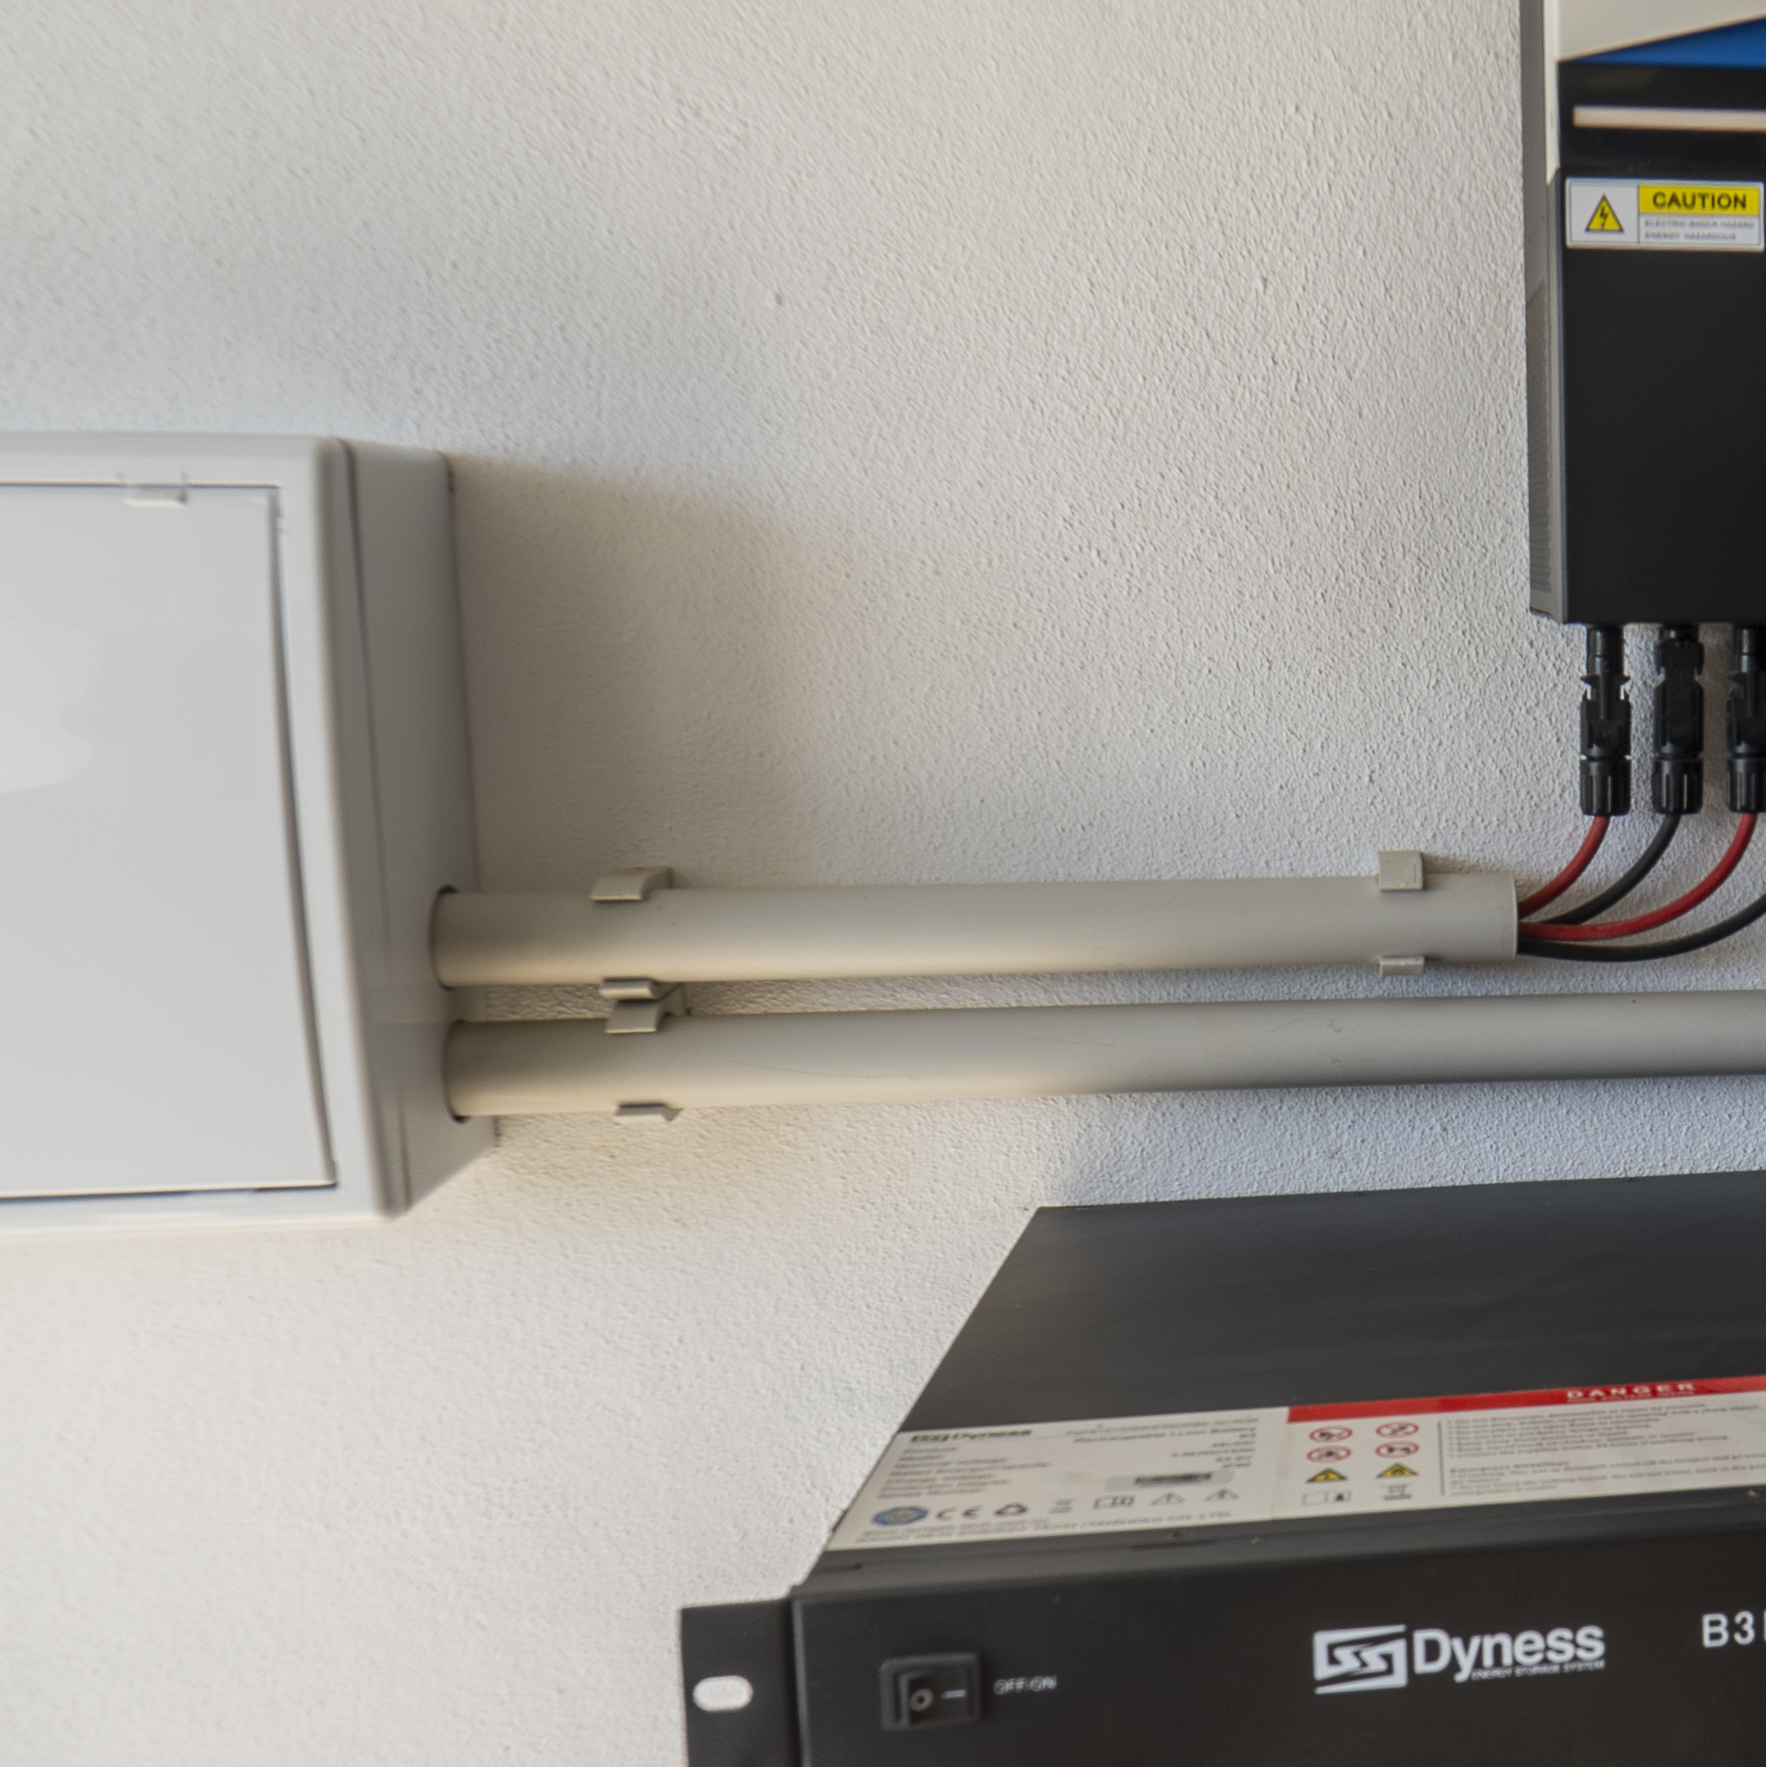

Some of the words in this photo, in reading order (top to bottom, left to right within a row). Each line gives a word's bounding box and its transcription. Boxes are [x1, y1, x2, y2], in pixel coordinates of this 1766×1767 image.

[1652, 191, 1747, 210] CAUTION
[1566, 1382, 1696, 1400] DANGER
[1702, 1611, 1756, 1647] B3
[1413, 1624, 1606, 1684] Dyness
